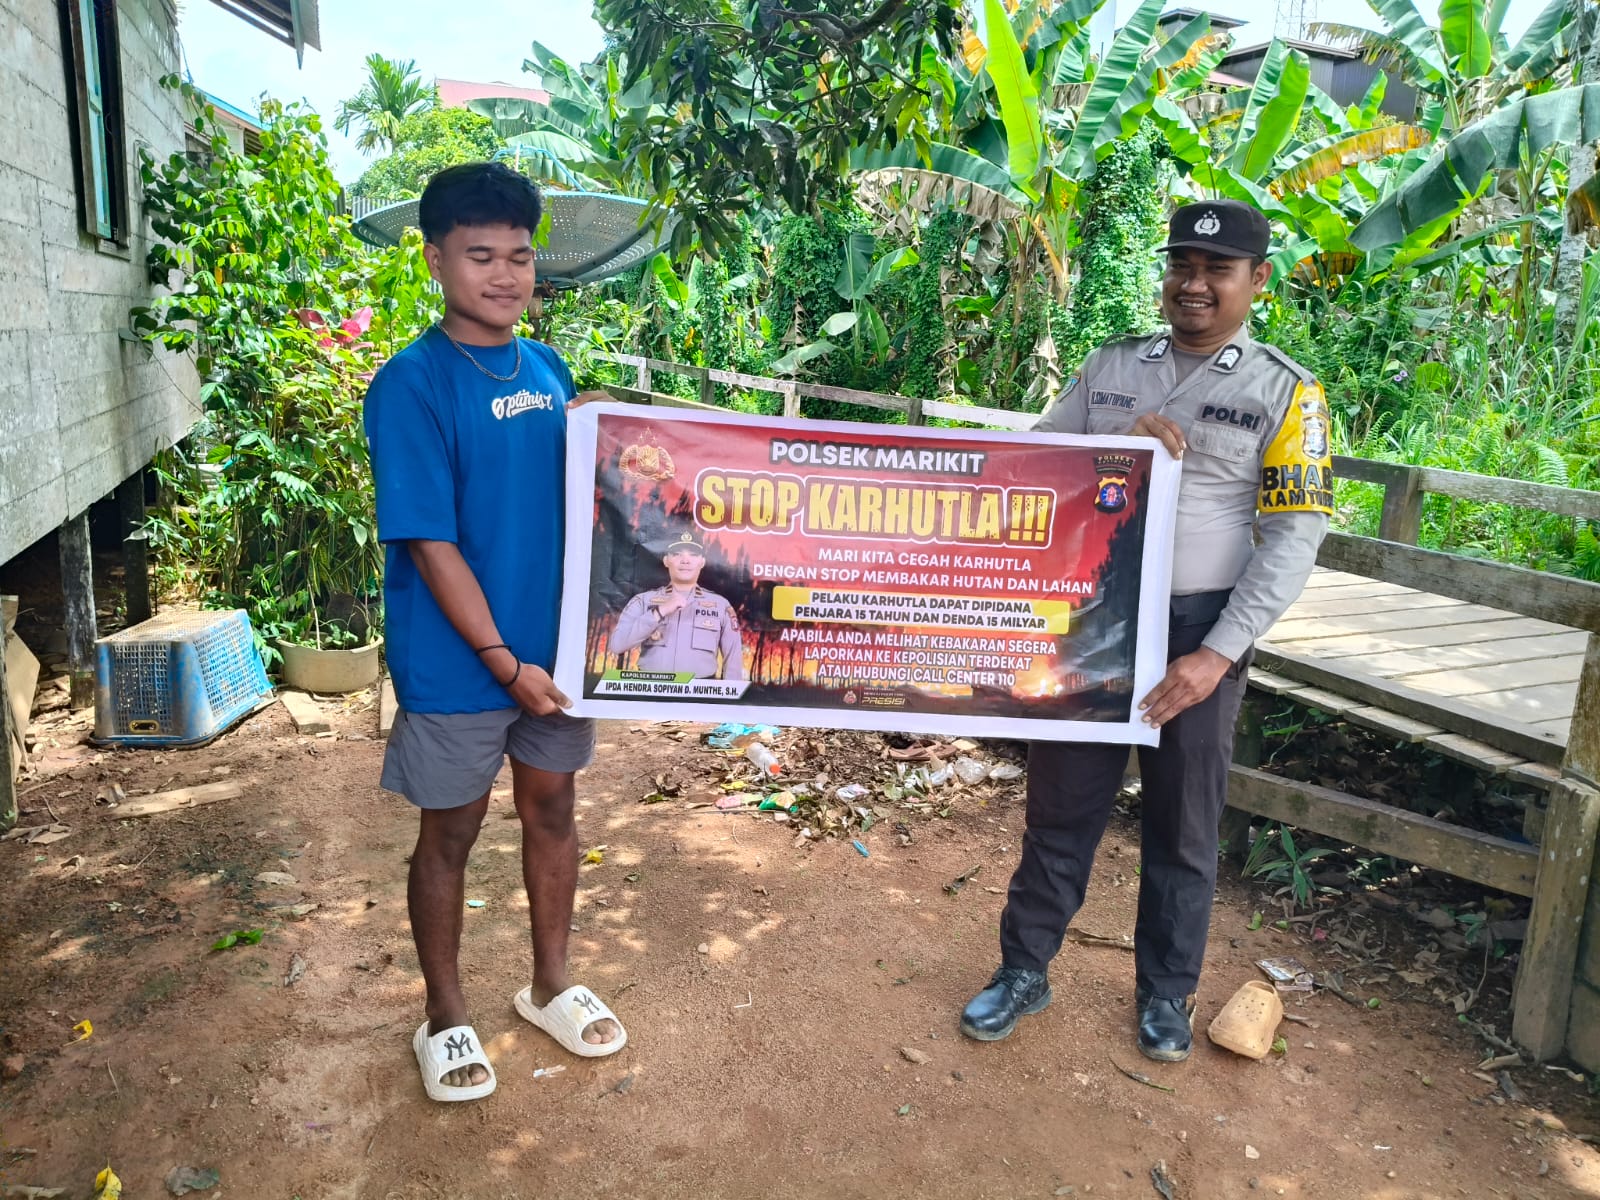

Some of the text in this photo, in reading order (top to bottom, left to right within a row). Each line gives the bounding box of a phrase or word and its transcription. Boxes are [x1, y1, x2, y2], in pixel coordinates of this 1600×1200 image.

[1202, 405, 1260, 430] POLRI
[772, 441, 984, 474] POLSEK MARIKIT
[702, 475, 1050, 542] STOP KARHUTLA !!!
[818, 548, 1032, 572] MARI KITA CEGAH KARHUTLA
[753, 564, 1093, 594] DENGAN STOP MEMBAKAR HUTAN DAN LAHAN
[695, 608, 719, 618] POLRI
[812, 592, 1032, 614] PELAKU KARHUTLA DAPAT DIPIDANA
[795, 606, 1046, 629] PENJARA 15 TAHUN DAN DENDA 15 MILYAR
[780, 628, 1056, 655] APABILA ANDA MELIHAT KEBAKARAN SEGERA
[804, 646, 1032, 670] LAPORKAN KE KEPOLISIAN TERDEKAT
[818, 664, 1015, 686] ATAU HUBUNGI CALL CENTER 110
[606, 682, 738, 696] IPDA HENDRA SOPIYAN D. MUNTHE, S.H.
[862, 696, 906, 706] PRESISI
